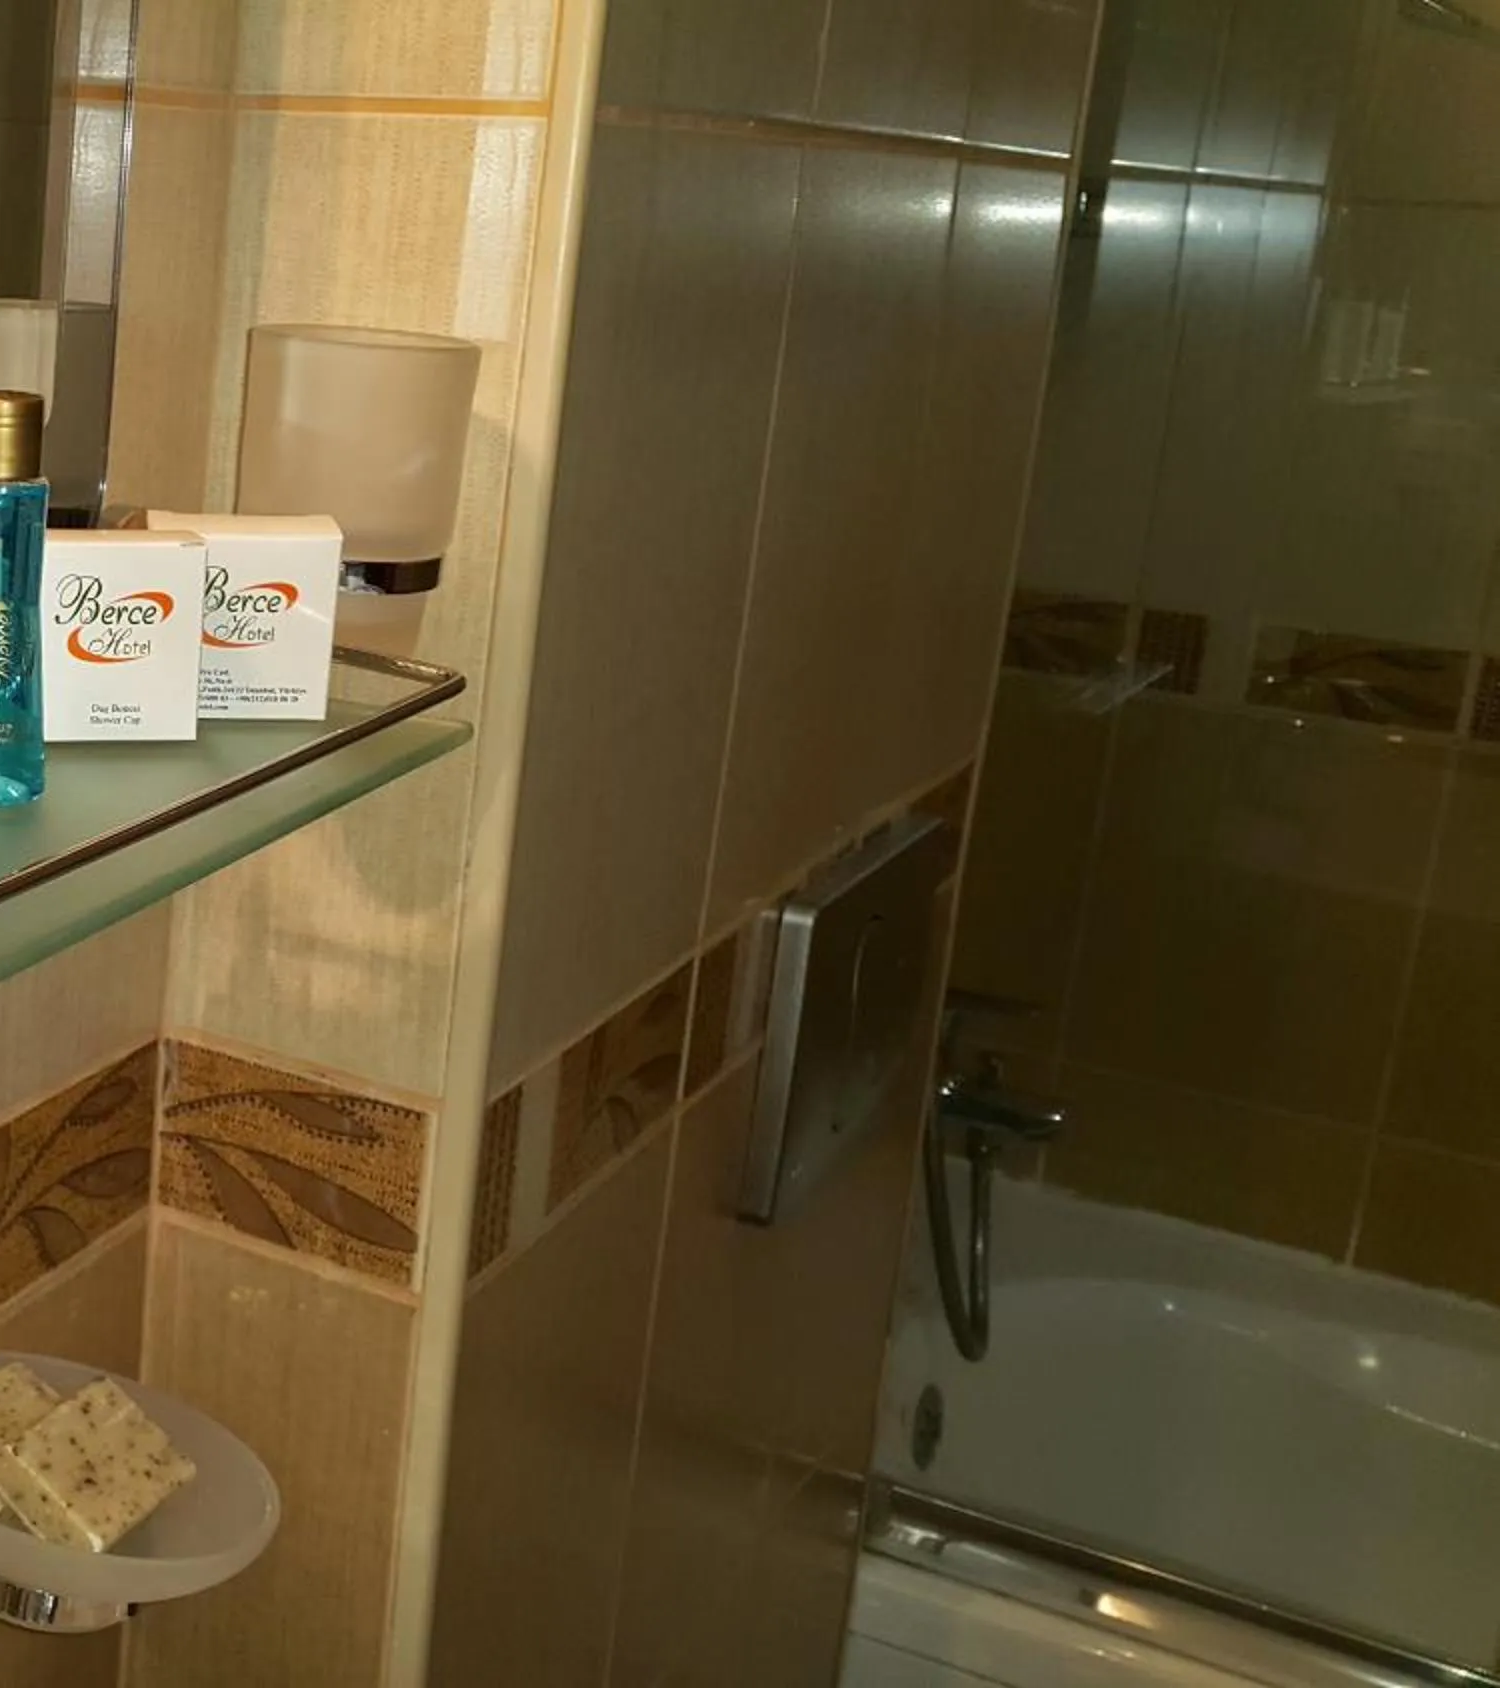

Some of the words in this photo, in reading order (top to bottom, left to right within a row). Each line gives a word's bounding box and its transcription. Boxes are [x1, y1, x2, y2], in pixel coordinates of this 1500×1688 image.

[55, 574, 157, 626] Berce
[202, 566, 282, 614] Berce
[88, 626, 152, 656] Hotel
[214, 617, 276, 643] Hotel
